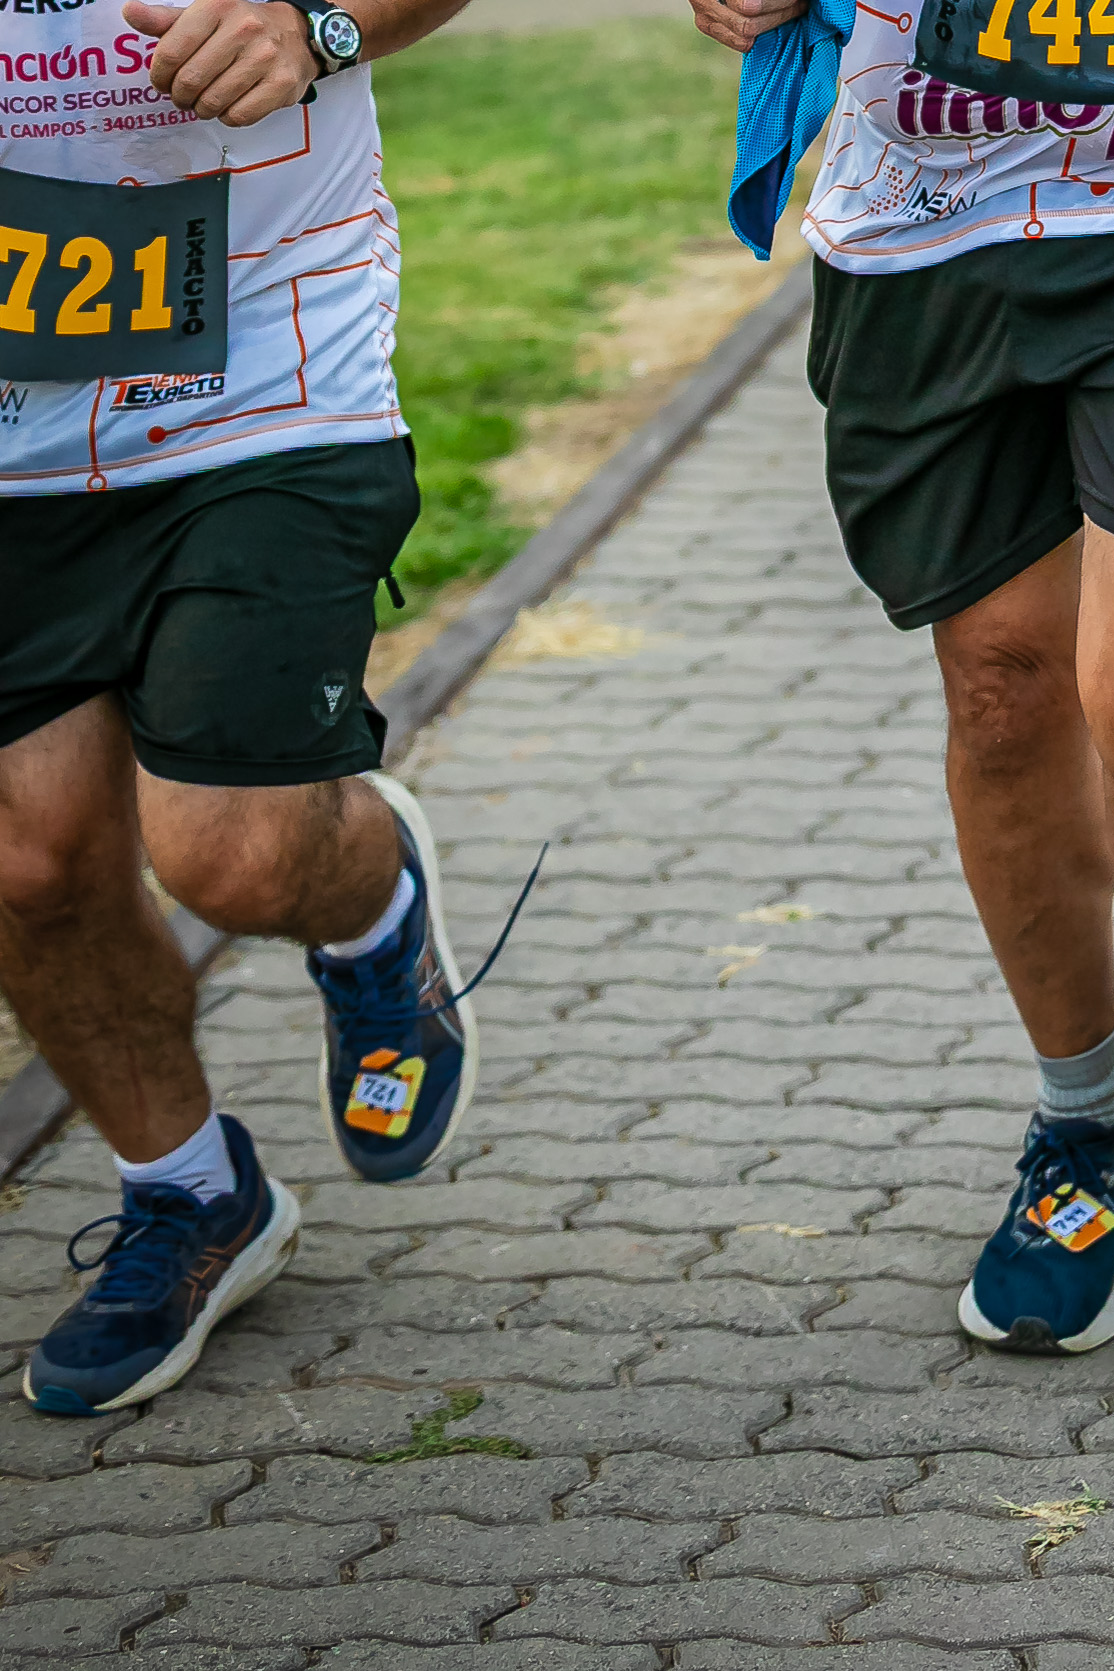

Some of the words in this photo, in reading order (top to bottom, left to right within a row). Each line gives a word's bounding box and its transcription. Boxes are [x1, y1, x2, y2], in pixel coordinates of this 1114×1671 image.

[63, 85, 171, 111] SEGURO
[11, 120, 86, 139] CAMPOS
[0, 225, 172, 335] 721
[181, 217, 206, 336] EXACTO
[123, 375, 225, 404] EXACTO
[364, 1077, 397, 1104] 721
